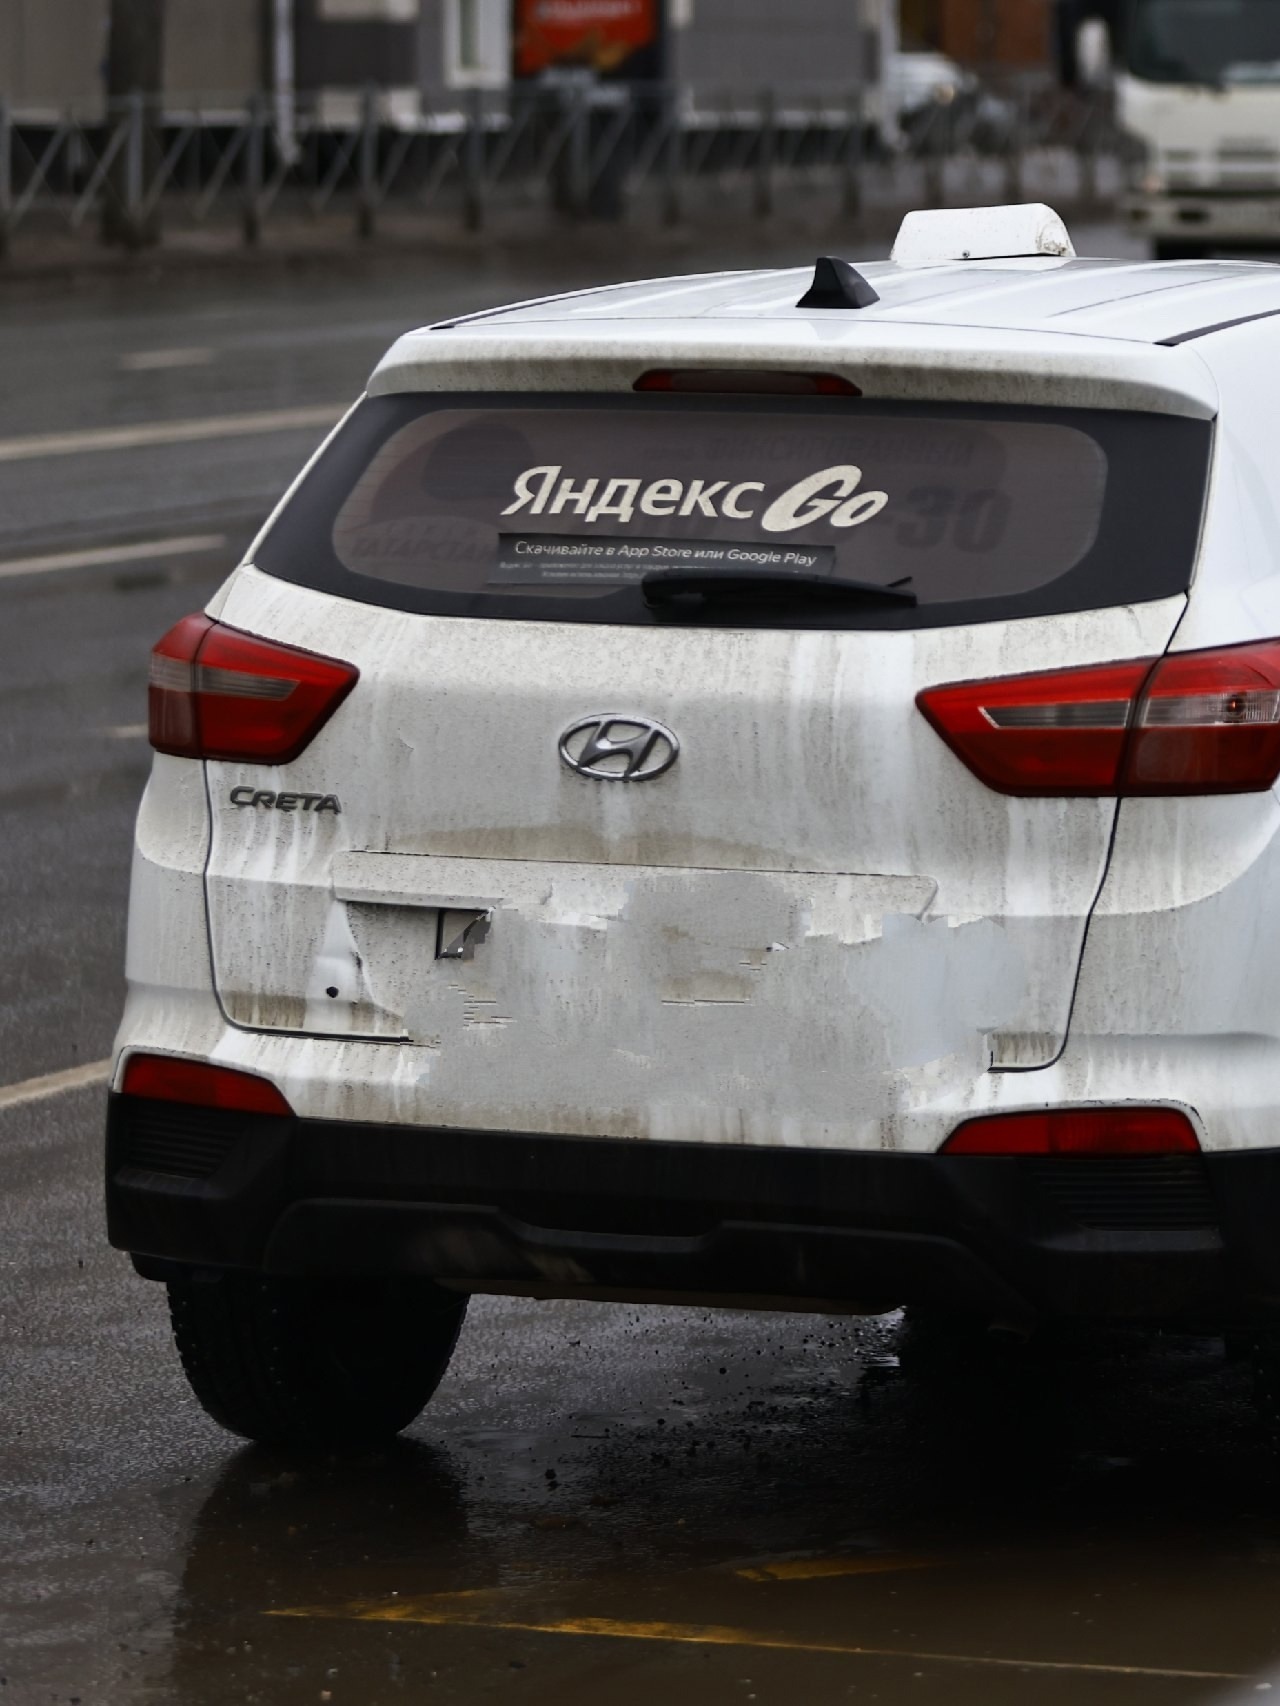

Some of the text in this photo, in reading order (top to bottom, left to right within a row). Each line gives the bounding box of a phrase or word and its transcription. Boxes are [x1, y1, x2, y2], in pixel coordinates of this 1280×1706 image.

[500, 464, 890, 532] Яндекс Go
[514, 540, 818, 568] Скачивайте в App Store или Google Play
[229, 785, 342, 815] CRETA
